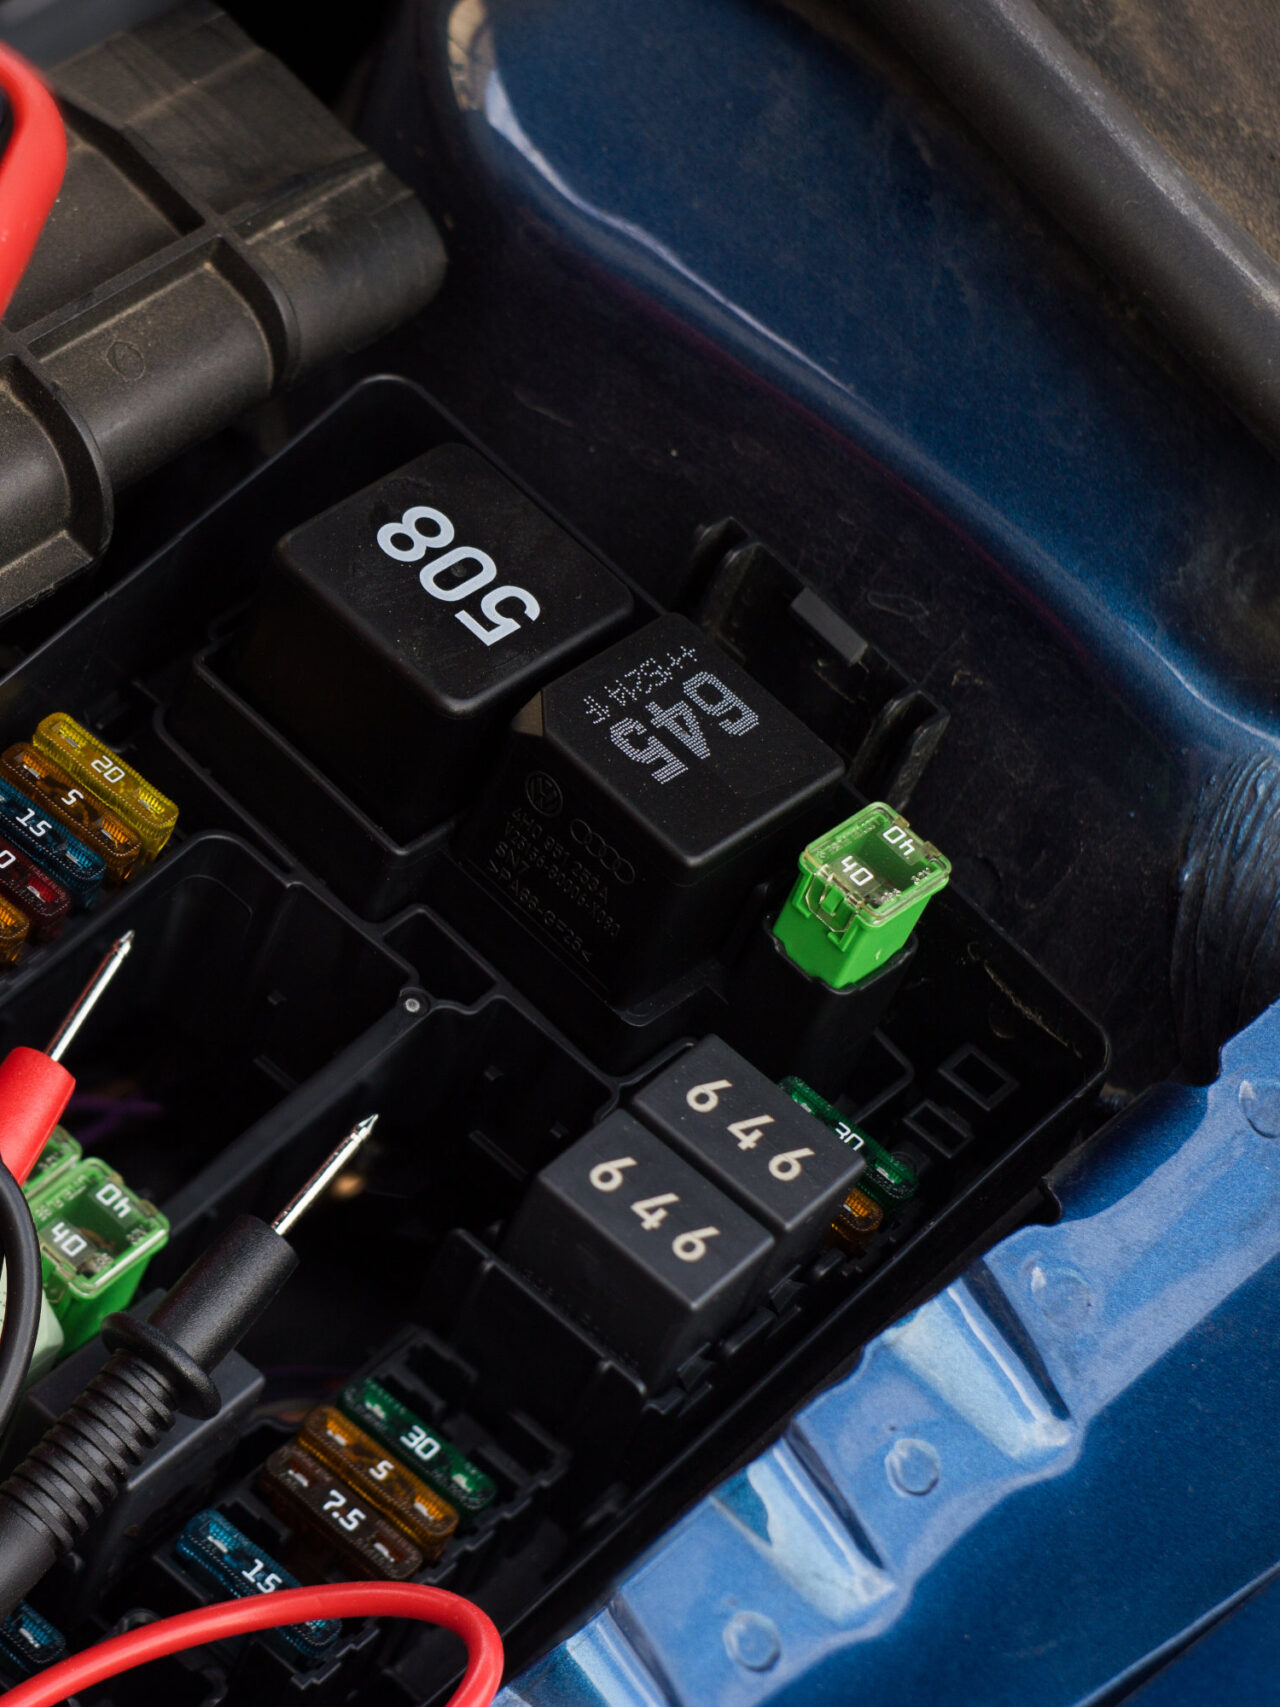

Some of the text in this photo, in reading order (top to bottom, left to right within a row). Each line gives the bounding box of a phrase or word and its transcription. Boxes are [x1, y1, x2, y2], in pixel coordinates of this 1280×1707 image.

[377, 505, 540, 647] 508
[609, 670, 760, 785] 645
[90, 755, 126, 785] 20
[60, 788, 85, 806] 5
[15, 807, 54, 839] 15
[882, 825, 916, 857] 40
[840, 855, 874, 887] 40
[686, 1079, 816, 1182] 646
[95, 1183, 132, 1219] 40
[589, 1156, 720, 1263] 646
[51, 1222, 88, 1258] 40
[400, 1425, 441, 1461] 30
[370, 1459, 394, 1482] 5
[322, 1489, 367, 1532] 7.5
[241, 1558, 283, 1594] 15
